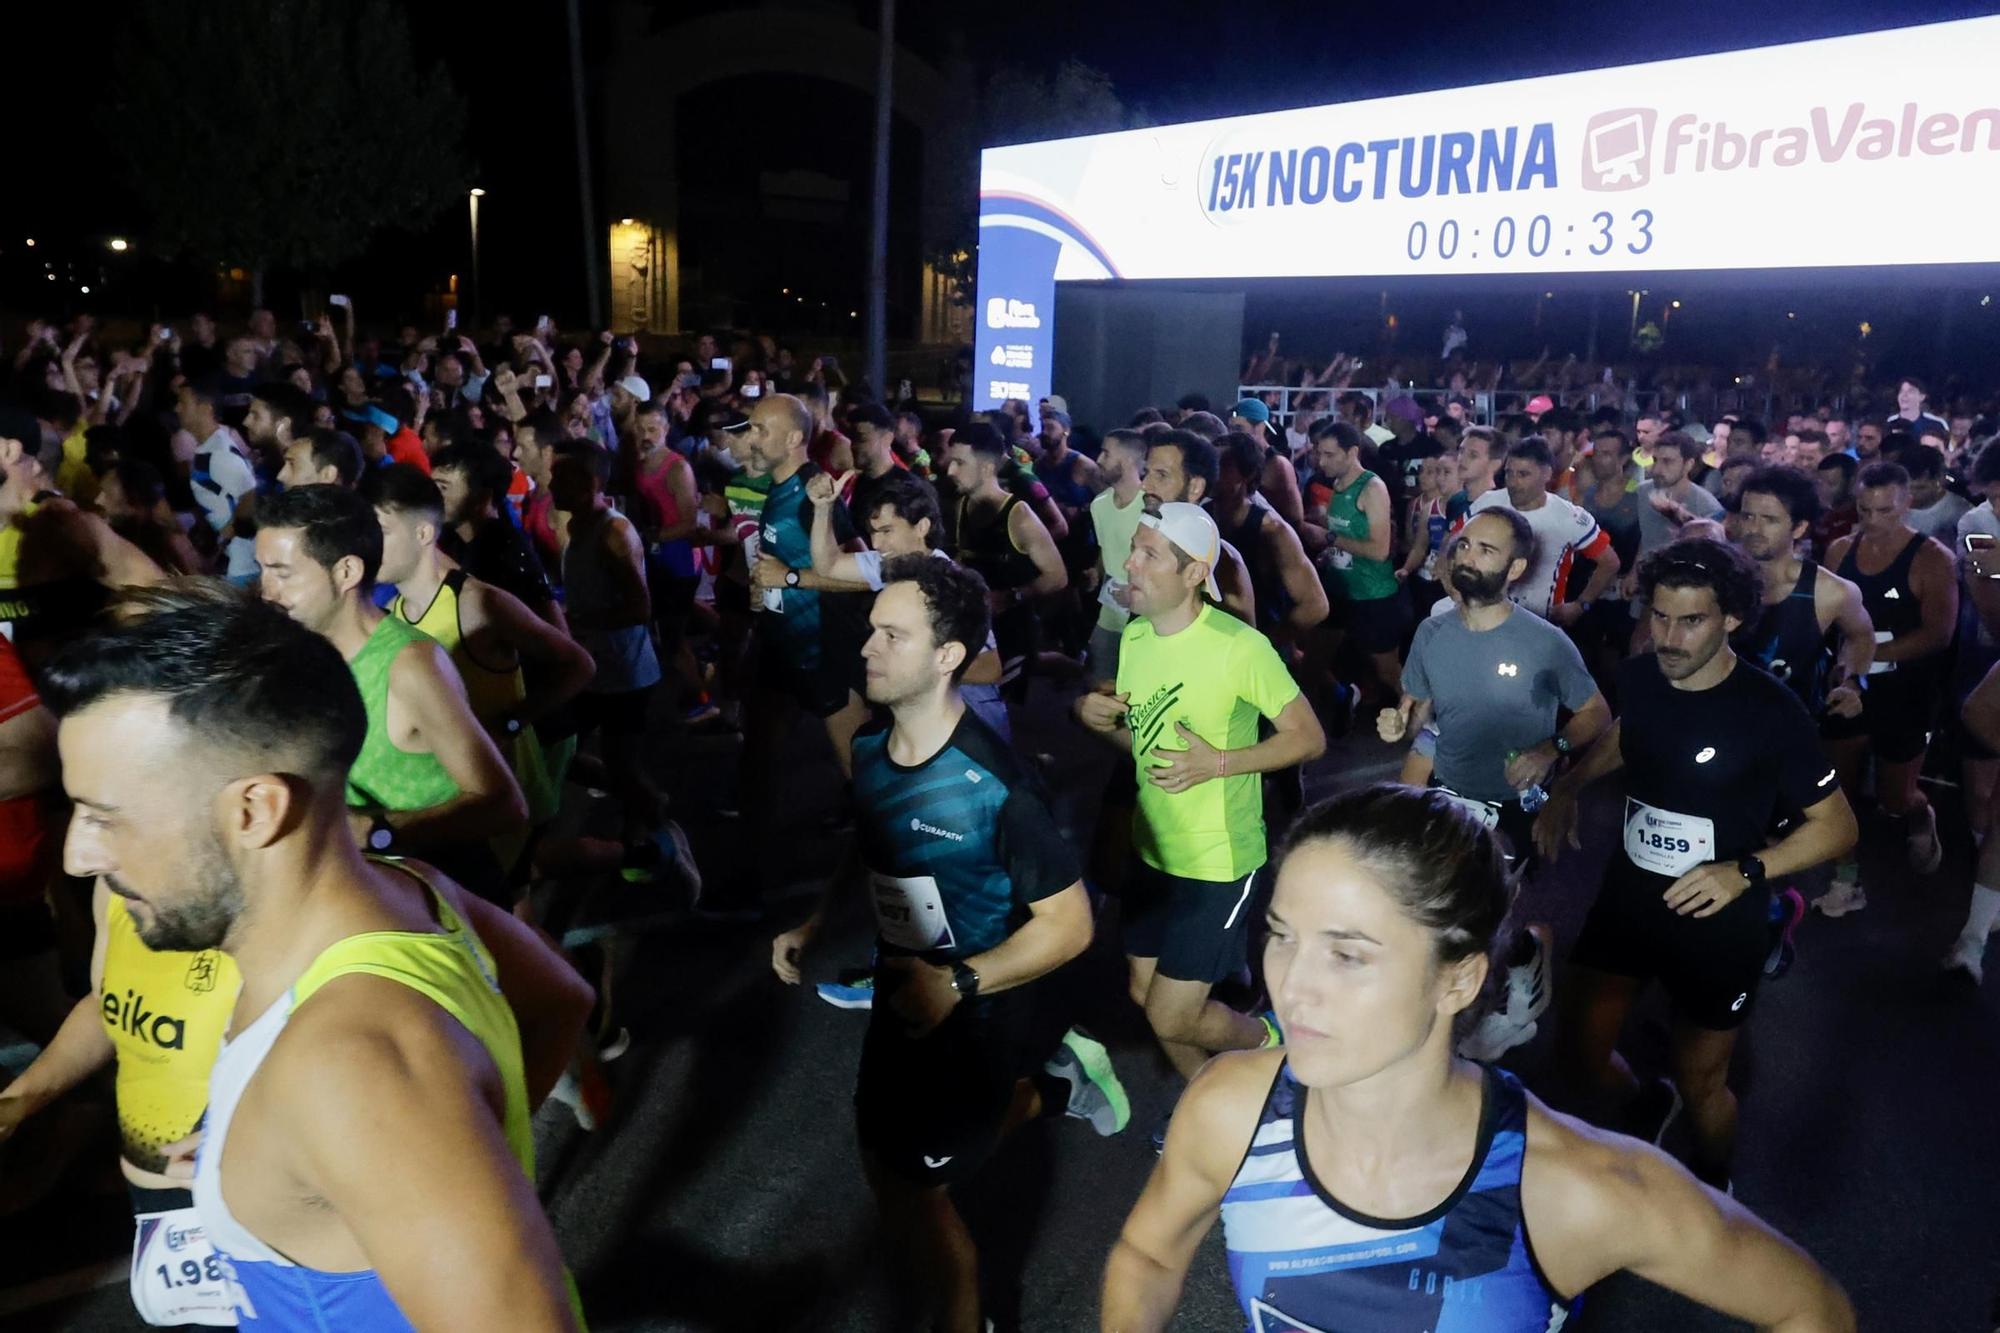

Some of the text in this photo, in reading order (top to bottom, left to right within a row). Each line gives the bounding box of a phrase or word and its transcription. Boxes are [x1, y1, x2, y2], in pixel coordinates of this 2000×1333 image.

[1207, 151, 1265, 212] 15K
[1266, 122, 1559, 207] NOCTURNA
[1638, 829, 1690, 852] 1.859
[101, 986, 186, 1051] eika
[157, 1254, 224, 1289] 1.98
